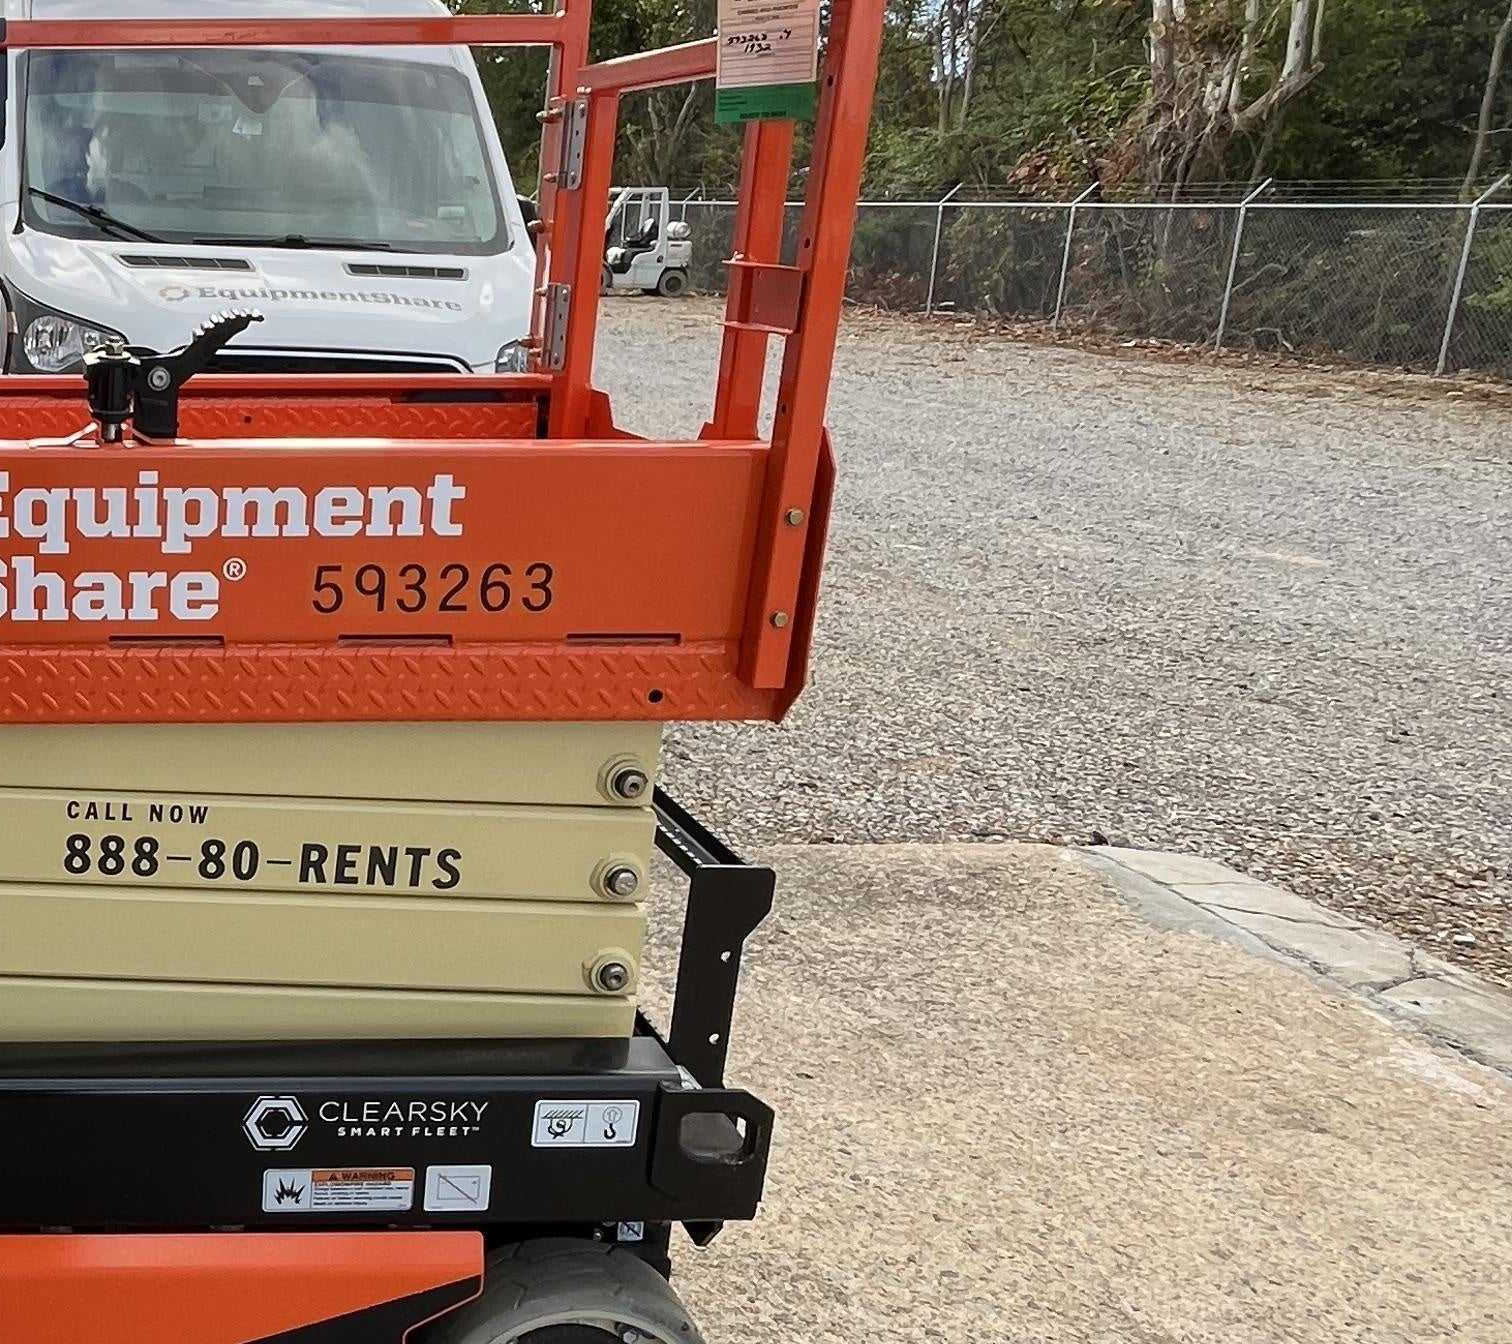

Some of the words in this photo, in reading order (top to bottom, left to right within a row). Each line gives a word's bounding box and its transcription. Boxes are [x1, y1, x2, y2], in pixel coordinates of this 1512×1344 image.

[196, 286, 463, 311] EquipmentShare
[311, 562, 554, 614] 593263
[66, 800, 134, 822] CALL
[149, 803, 209, 824] NOW
[63, 833, 463, 889] 888-80-RENTS
[319, 1101, 489, 1122] CLEARSKY
[337, 1126, 404, 1137] SMART
[341, 1171, 396, 1181] WARNING
